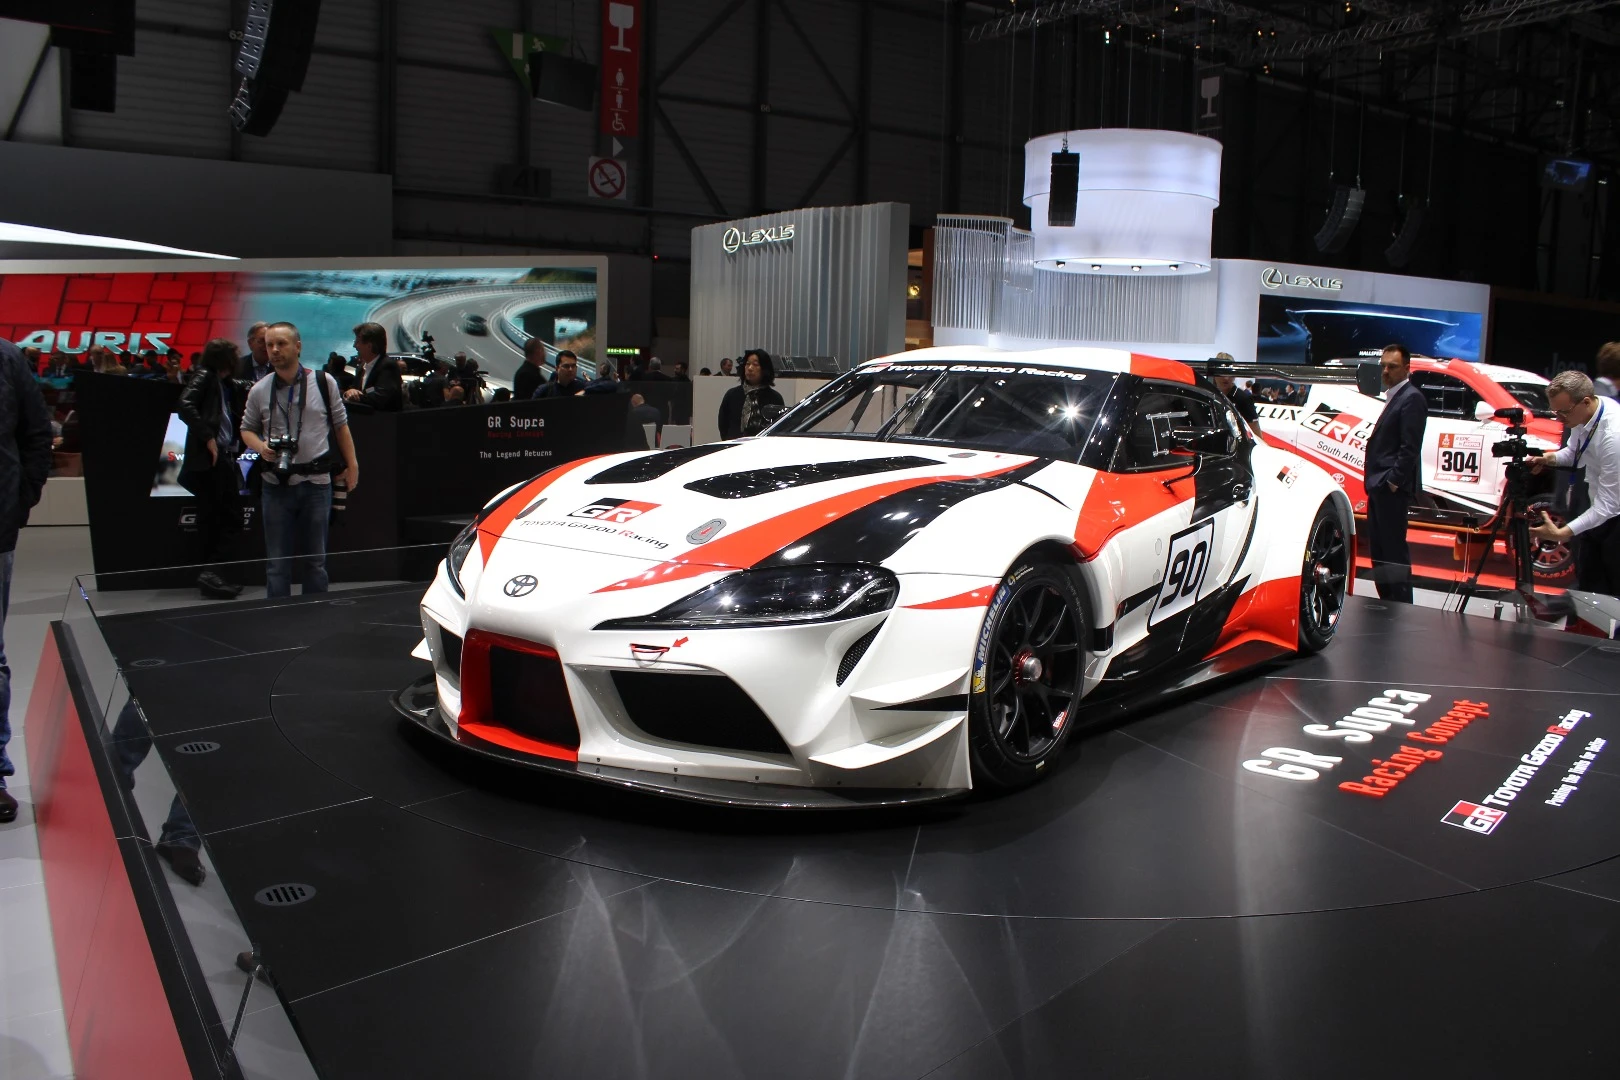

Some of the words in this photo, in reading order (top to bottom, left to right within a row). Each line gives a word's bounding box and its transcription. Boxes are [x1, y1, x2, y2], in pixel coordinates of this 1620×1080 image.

[742, 224, 795, 246] LEXUS
[1284, 273, 1343, 291] LEXUS
[14, 329, 172, 355] AURIS
[948, 365, 1016, 374] GAZOO
[1018, 367, 1087, 381] Racing
[487, 416, 502, 428] GR
[510, 416, 545, 430] Supra
[1306, 413, 1351, 442] GR
[496, 450, 521, 459] Legend
[524, 449, 552, 457] Returns
[1316, 440, 1341, 457] South
[1442, 451, 1479, 474] 304
[571, 504, 643, 524] GR
[567, 522, 618, 534] GAZOO
[618, 529, 669, 549] Racing
[1159, 540, 1207, 609] 90
[977, 585, 1007, 662] MICHELIN
[1243, 747, 1343, 780] GR
[1303, 689, 1432, 743] Supra
[1338, 745, 1443, 797] Racing
[1406, 699, 1490, 744] Concept
[1482, 764, 1539, 807] TOYOTA
[1521, 733, 1564, 766] GAZOO
[1547, 709, 1592, 736] Racing
